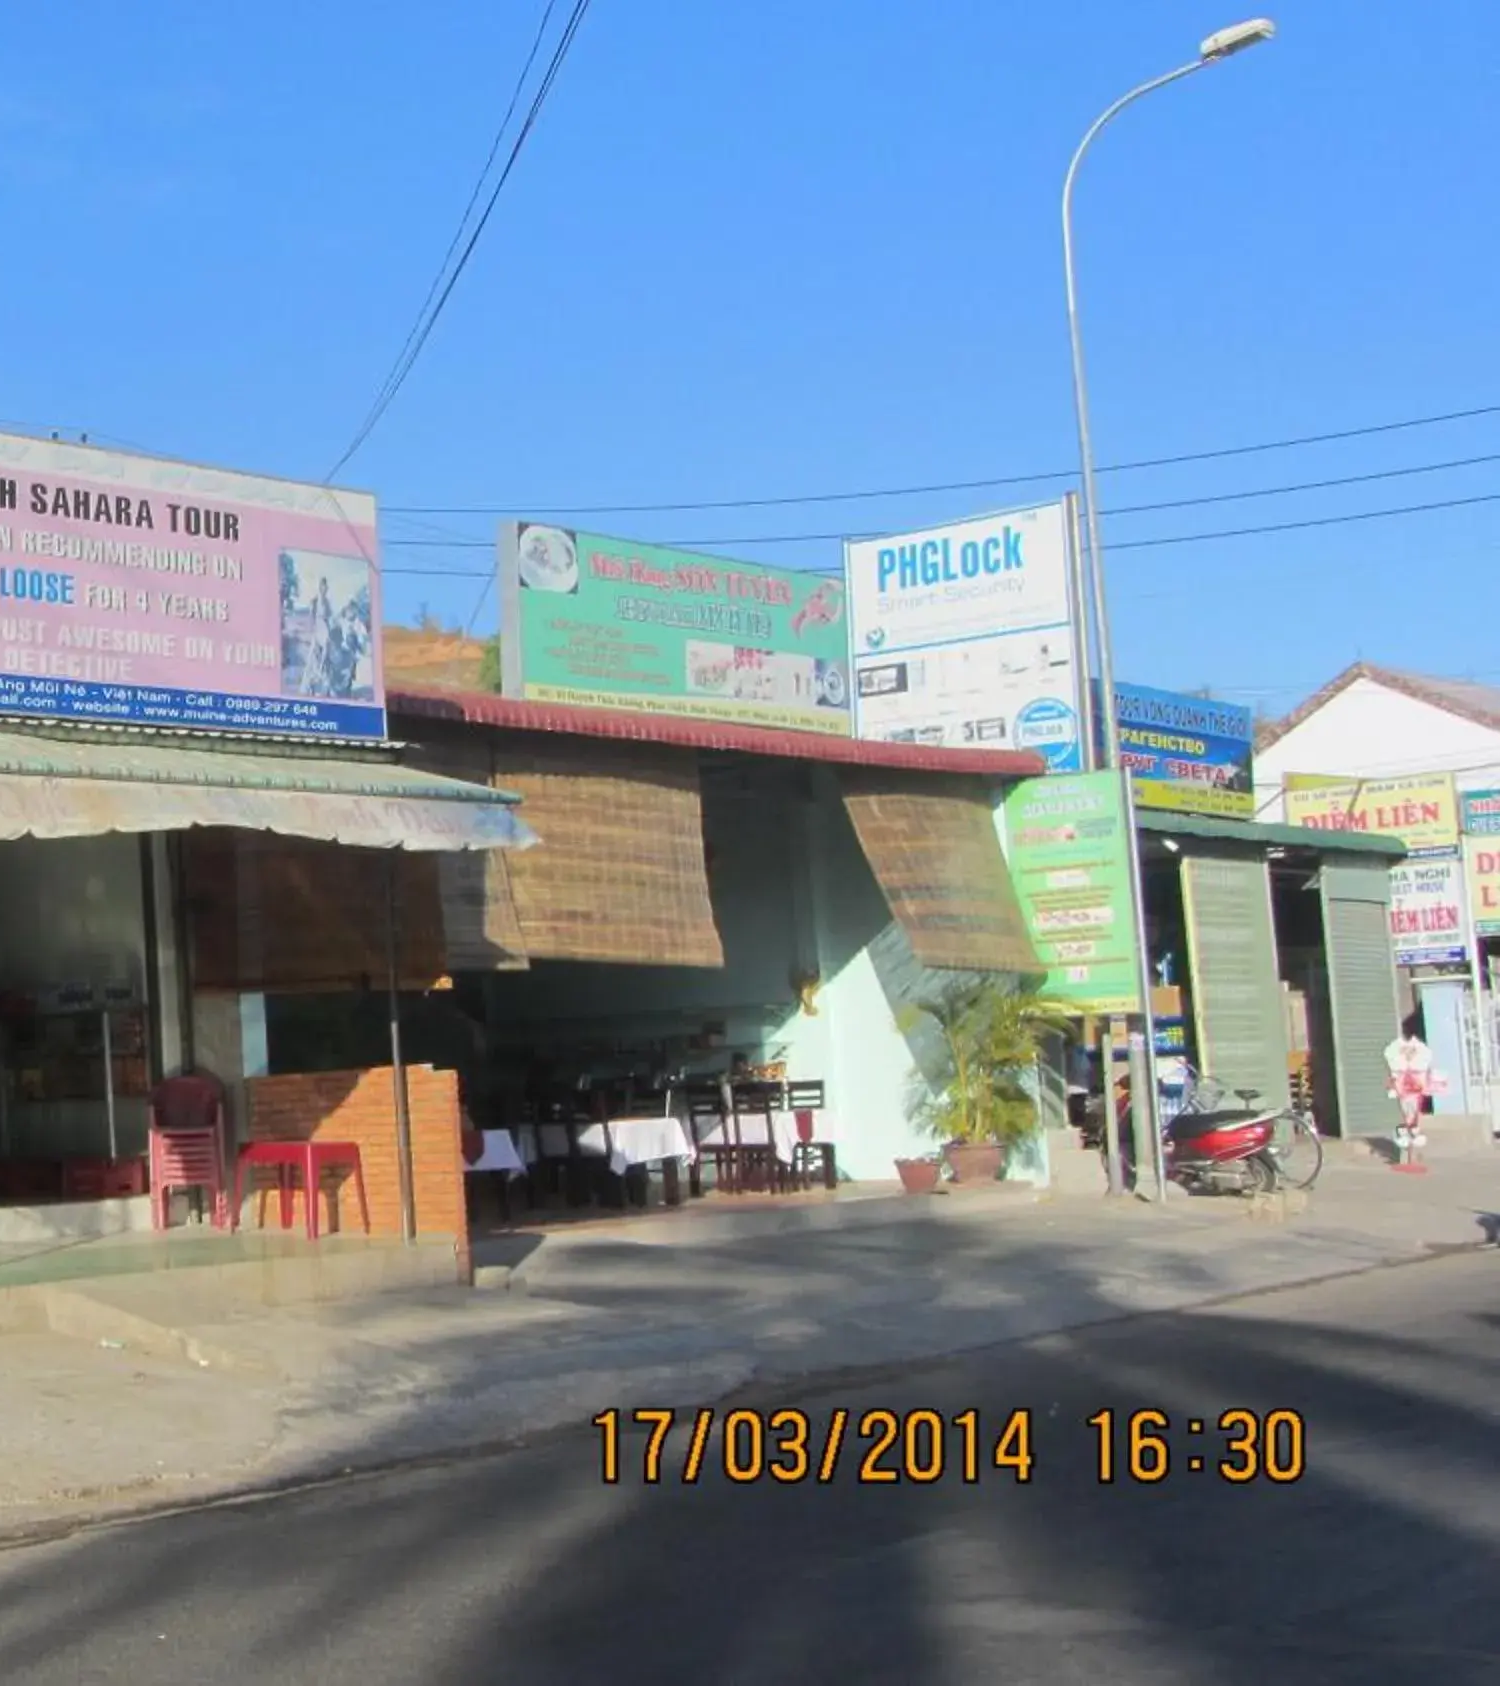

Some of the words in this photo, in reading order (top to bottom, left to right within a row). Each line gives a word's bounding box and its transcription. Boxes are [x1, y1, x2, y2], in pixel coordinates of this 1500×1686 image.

[30, 482, 154, 530] SAHARA
[167, 503, 239, 542] TOUR
[20, 528, 208, 577] RECOMMENDING
[0, 566, 76, 606] LOOSE
[86, 582, 128, 613] FOR
[135, 590, 151, 613] 4
[158, 592, 230, 623] YEARS
[877, 591, 935, 615] Smart
[944, 575, 1028, 604] Security
[3, 646, 134, 682] DETECTIVE
[57, 622, 178, 658] AWESOME
[222, 641, 277, 669] YOUR
